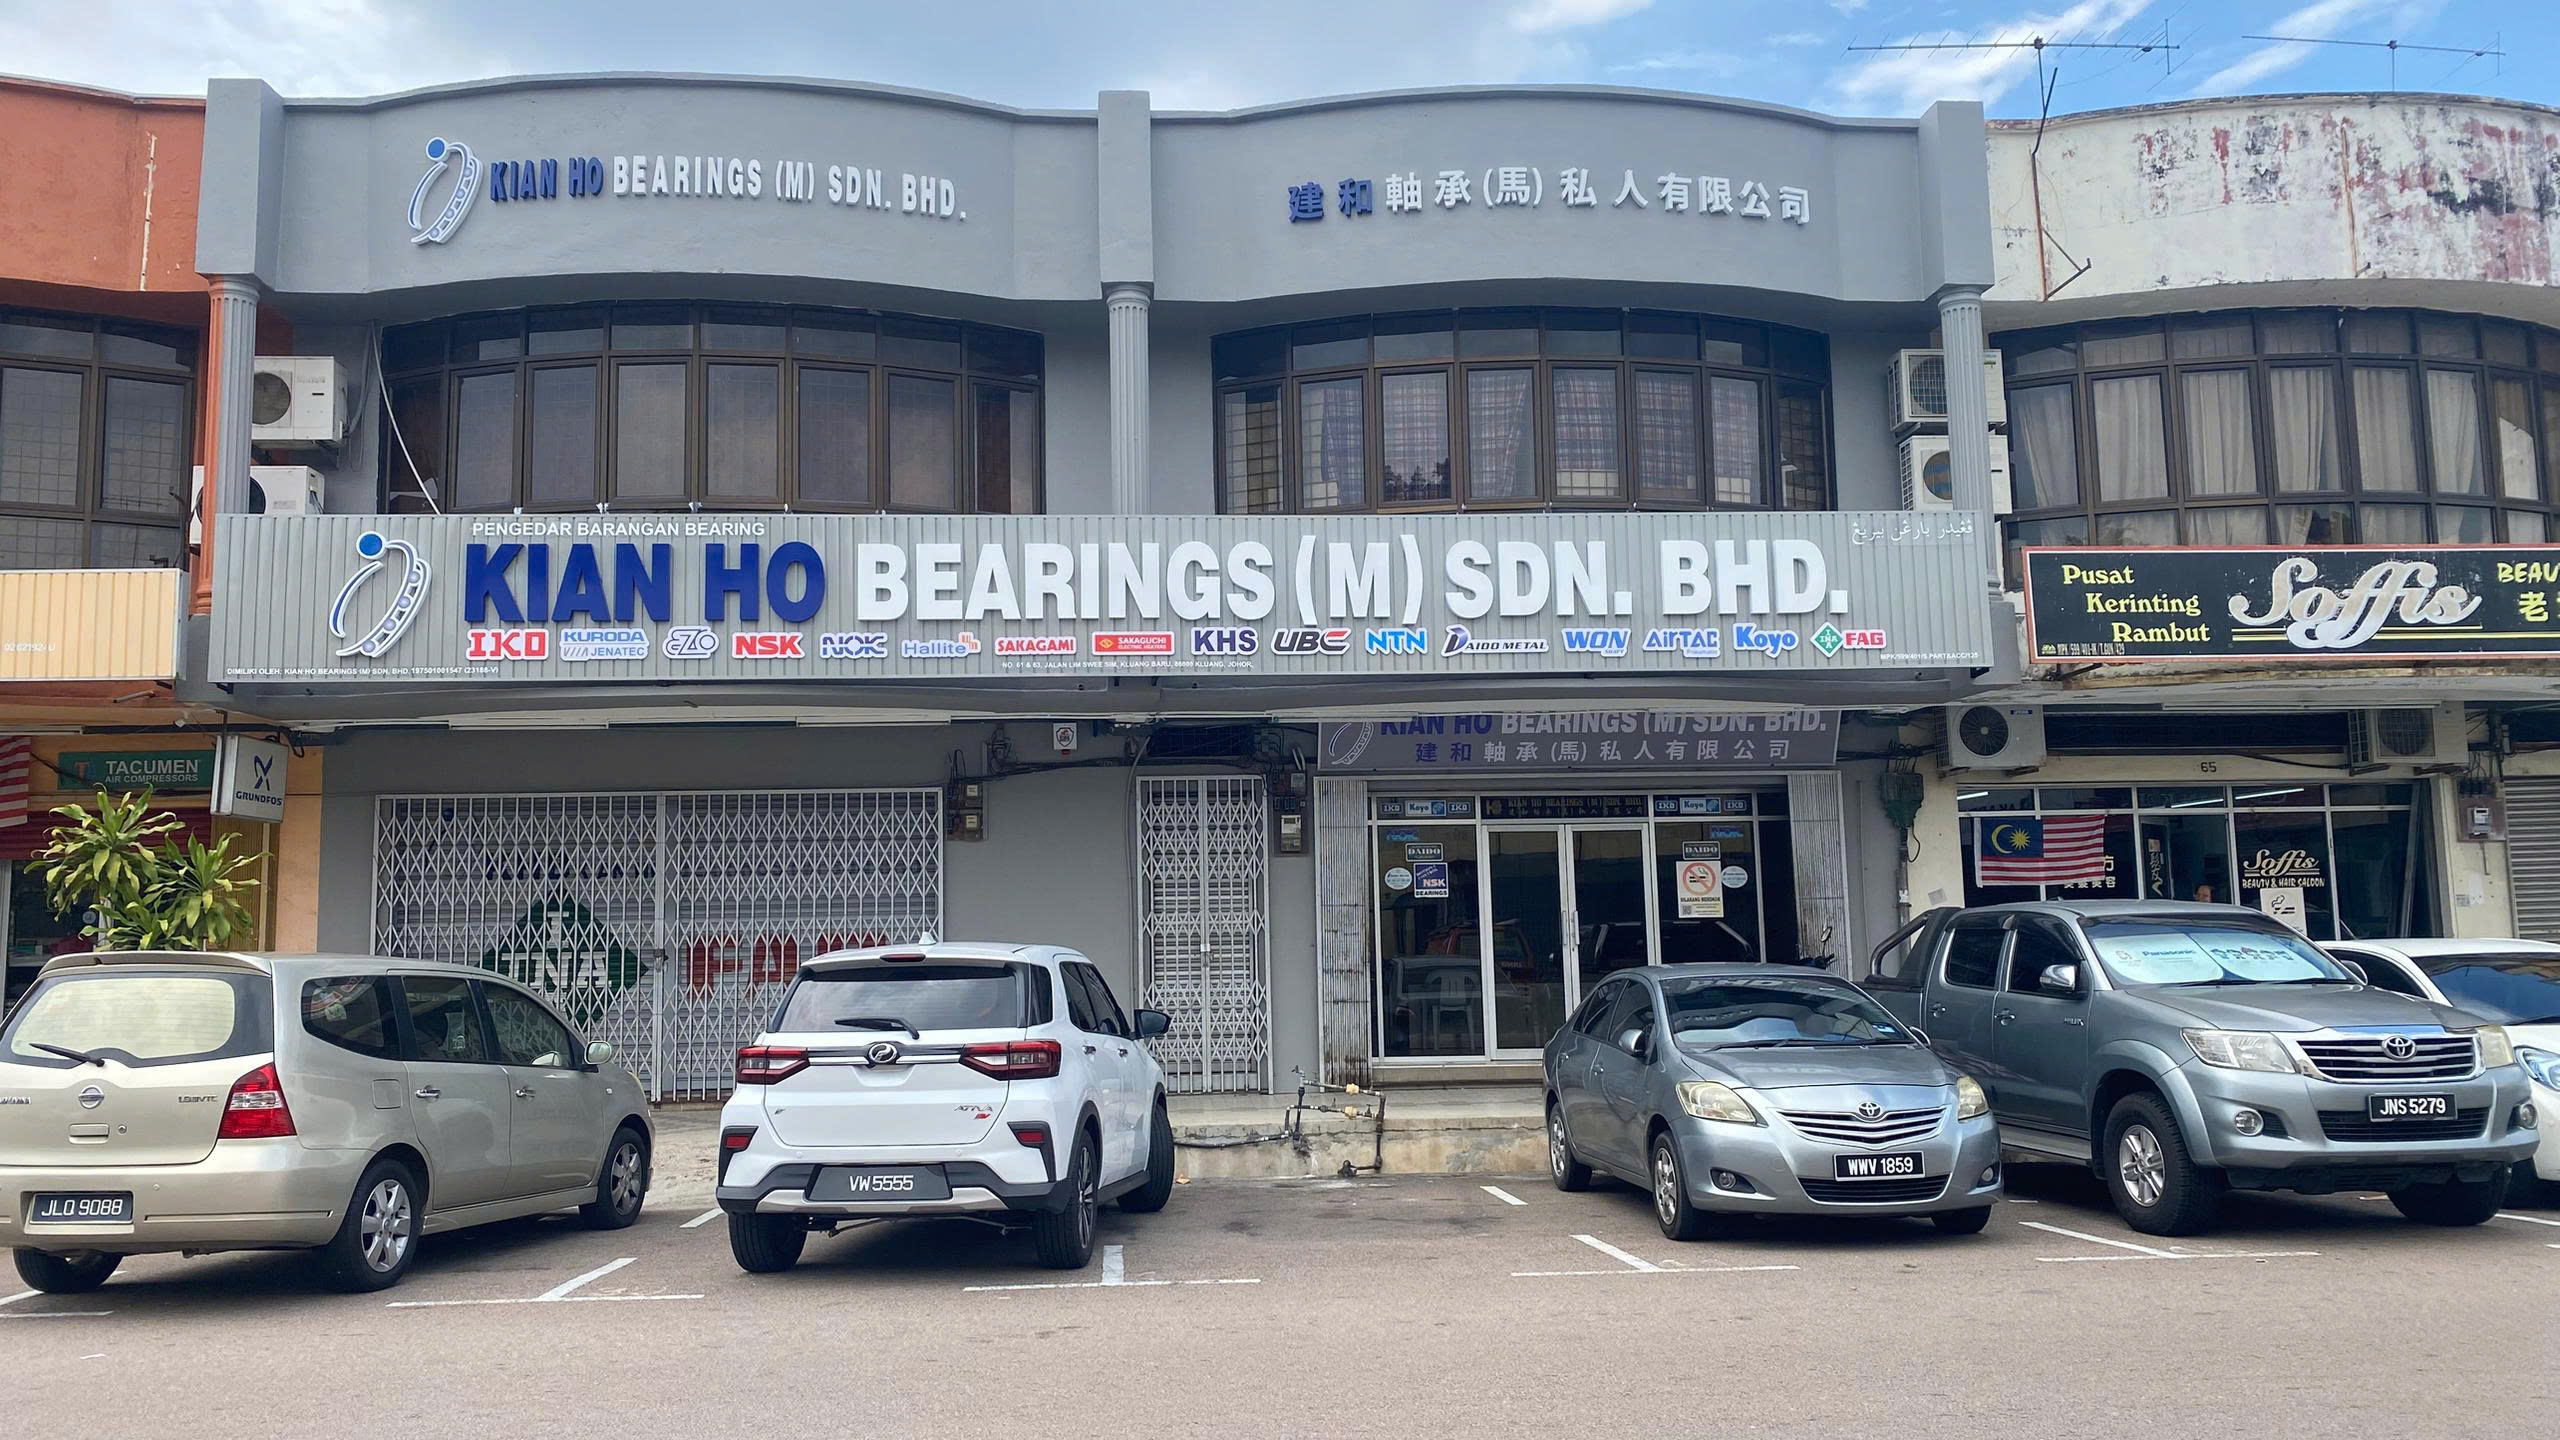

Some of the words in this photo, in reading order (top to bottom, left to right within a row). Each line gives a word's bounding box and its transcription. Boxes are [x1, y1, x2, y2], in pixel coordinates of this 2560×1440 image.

[490, 158, 557, 201] KIAN
[568, 156, 604, 197] HO
[613, 155, 763, 198] BEARINGS
[775, 159, 815, 201] (M)
[827, 164, 892, 211] SDN.
[902, 172, 967, 221] BHD.
[472, 522, 572, 536] PENGEDAR
[577, 522, 680, 537] BARANGAN
[685, 522, 766, 537] BEARING
[464, 542, 672, 623] KIAN
[704, 541, 825, 623] HO
[857, 540, 1275, 622] BEARINGS
[1295, 533, 1424, 626] (M)
[1445, 539, 1633, 620] SDN.
[1660, 539, 1848, 615] BHD.
[2061, 564, 2135, 585] Pusat
[2497, 562, 2560, 584] BEAU
[2086, 592, 2201, 616] Kerinting
[2228, 557, 2483, 649] Soffis
[2519, 591, 2560, 622] 老
[562, 630, 646, 643] KURODA
[1194, 629, 1256, 652] KHS
[1275, 630, 1349, 652] UBC
[1368, 630, 1427, 653] NTN
[1566, 631, 1629, 649] WON
[1735, 626, 1796, 655] Koyo
[1845, 632, 1884, 646] FAG
[2111, 621, 2211, 643] Rambut
[468, 631, 547, 657] IKO
[590, 646, 645, 657] JENATEC
[735, 635, 801, 656] NSK
[822, 635, 885, 655] NOK
[904, 642, 967, 655] Hallite
[997, 639, 1074, 653] SAKAGAMI
[1502, 641, 1547, 650] METAL
[1454, 715, 1494, 736] HO
[1501, 712, 1638, 734] BEARINGS
[1643, 712, 1686, 734] (M)
[1764, 710, 1827, 732] BHD.
[106, 759, 199, 775] TACUMEN
[2200, 761, 2217, 773] 65
[105, 775, 121, 783] AIR
[124, 774, 198, 783] COMPRESSORS
[236, 790, 282, 807] GRUNDFOS
[1408, 803, 1430, 812] Koyo
[1684, 800, 1704, 809] Koyo
[2243, 849, 2319, 876] Soffis
[1423, 878, 1446, 887] NSK
[2242, 878, 2269, 888] BEAUTY
[2271, 877, 2278, 888] &
[2278, 877, 2296, 887] HAIR
[2297, 876, 2325, 887] SALOON
[2379, 1098, 2407, 1116] JNS
[2408, 1097, 2446, 1115] 5279
[1847, 1158, 1878, 1176] WWV
[1880, 1156, 1914, 1174] 1859
[848, 1173, 873, 1192] VW
[873, 1173, 914, 1191] 5555
[41, 1199, 75, 1216] JLQ
[79, 1199, 123, 1216] 9088
